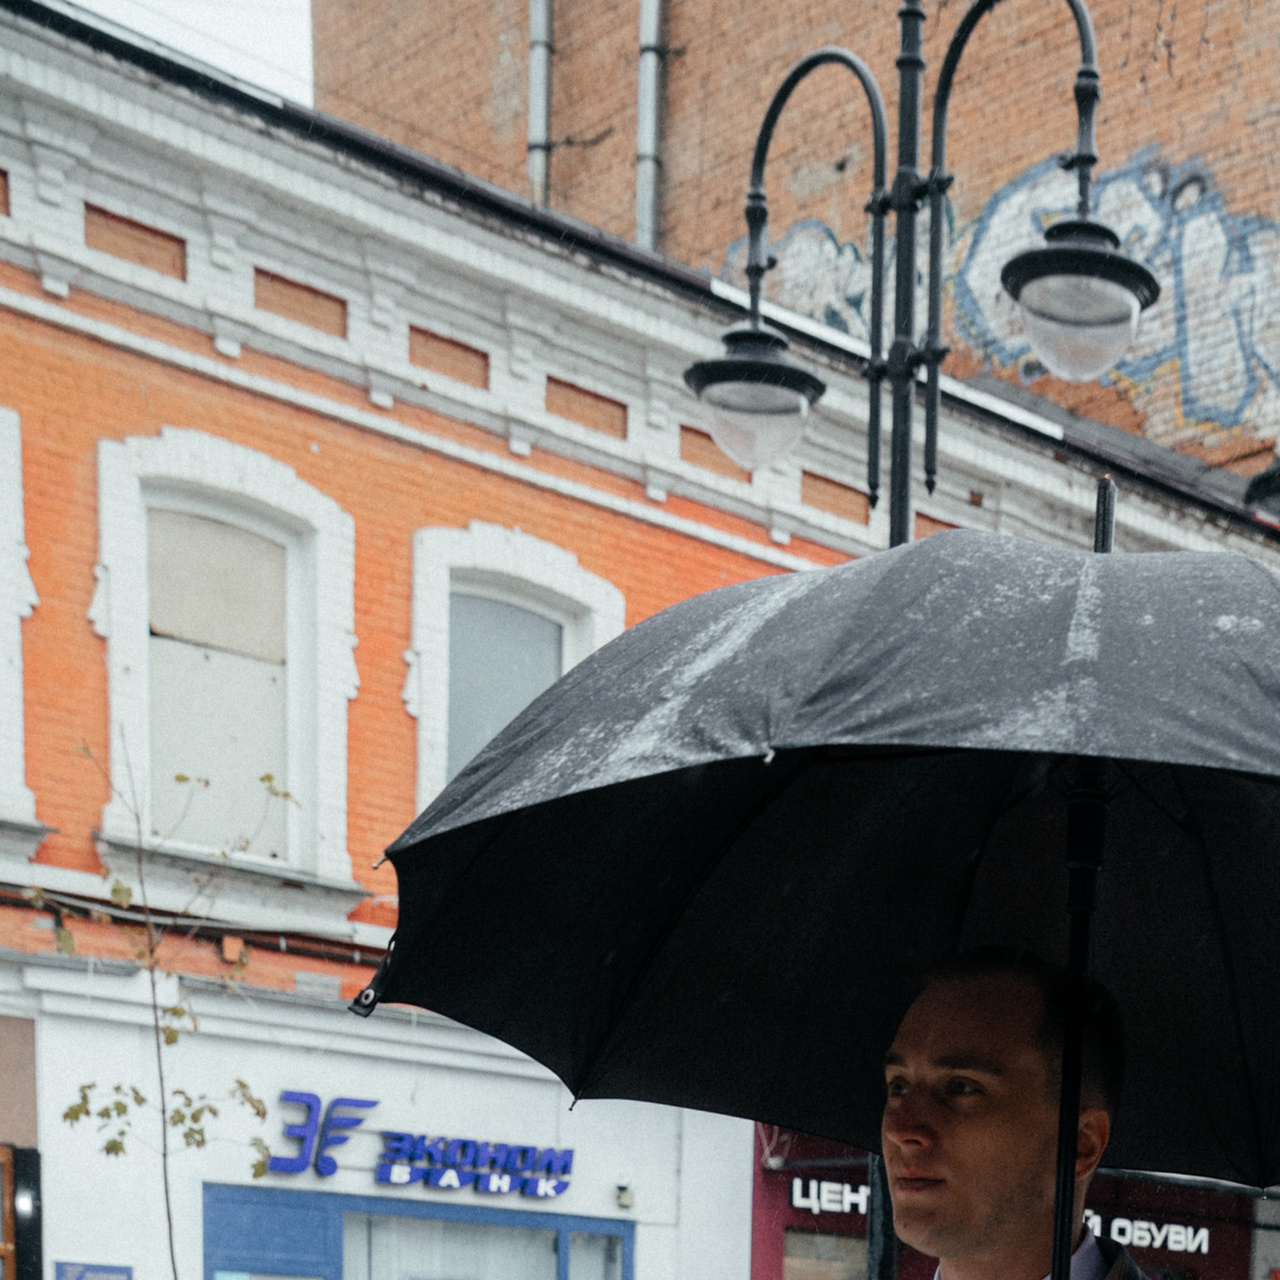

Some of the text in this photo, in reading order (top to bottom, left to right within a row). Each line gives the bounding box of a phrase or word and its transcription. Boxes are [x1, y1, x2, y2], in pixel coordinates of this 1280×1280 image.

[379, 1131, 574, 1175] ЭКОНОМ
[389, 1164, 559, 1198] БАНК
[792, 1177, 871, 1215] ЦЕН
[1110, 1217, 1209, 1254] ОБУВИ
